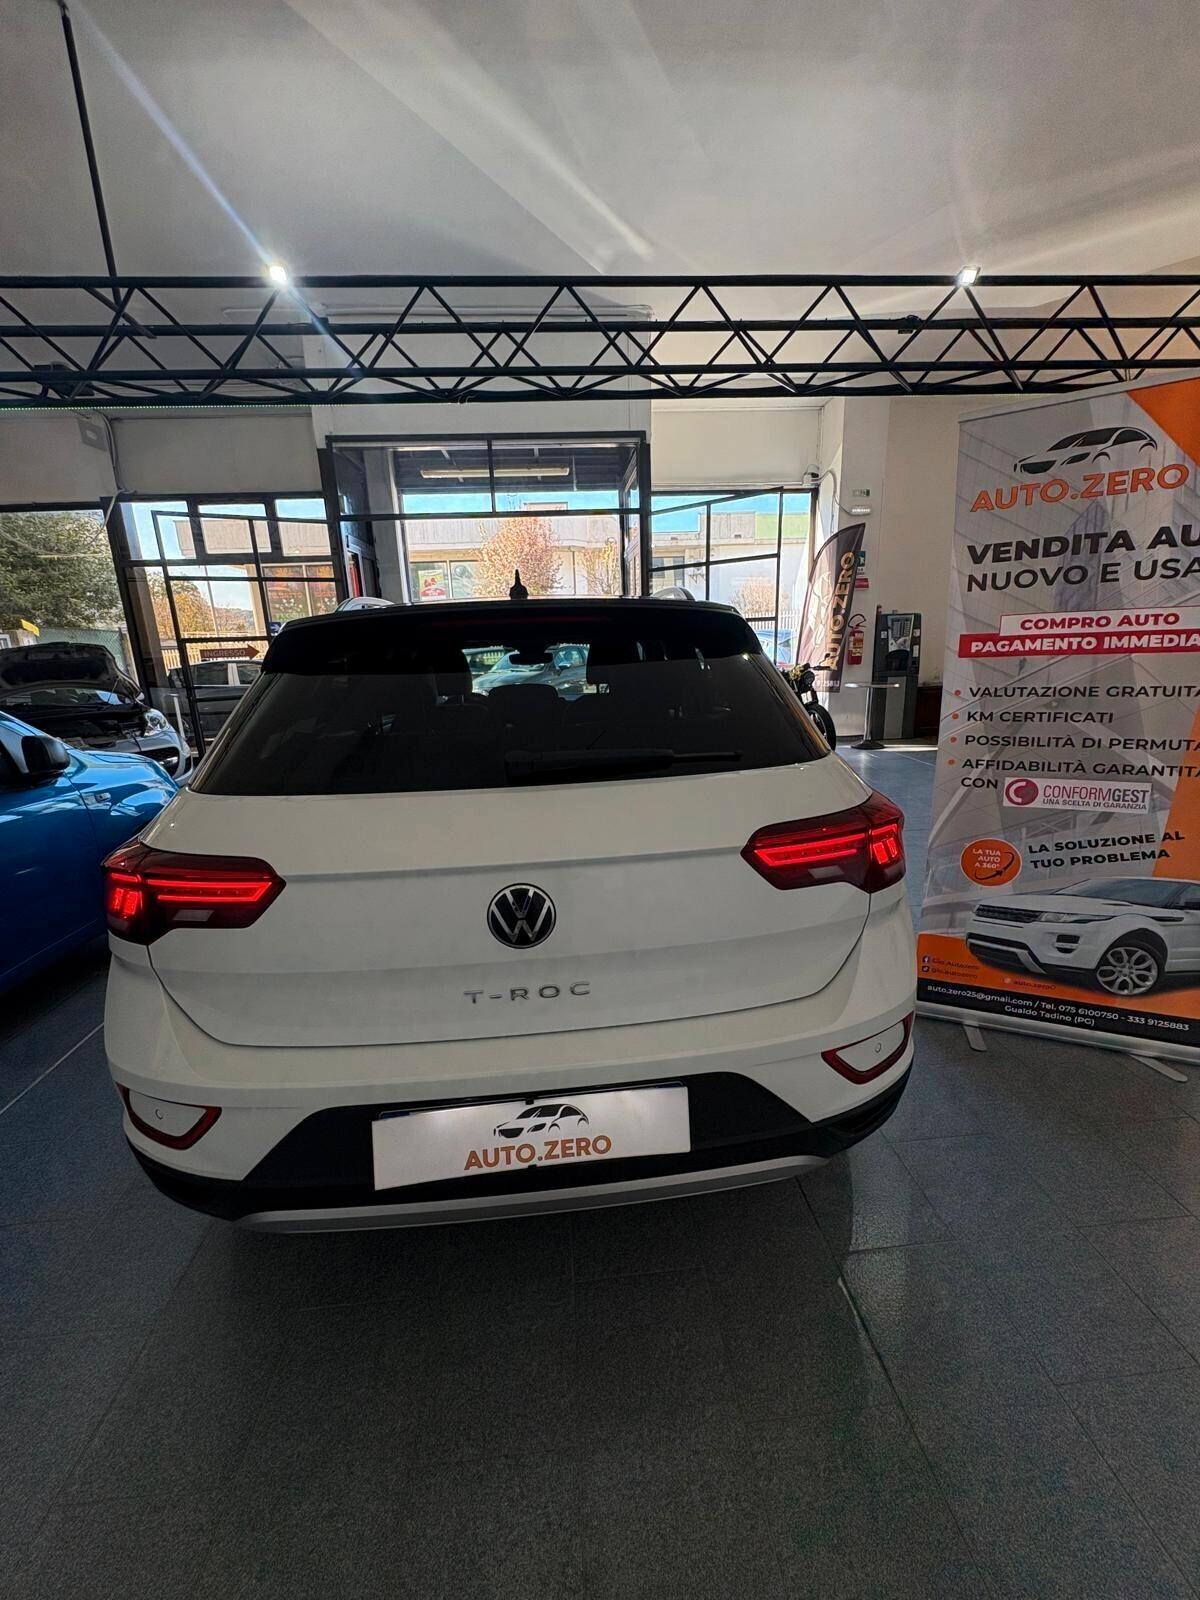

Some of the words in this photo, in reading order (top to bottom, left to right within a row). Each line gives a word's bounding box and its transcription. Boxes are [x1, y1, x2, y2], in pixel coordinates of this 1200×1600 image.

[970, 463, 1189, 513] AUTO.ZERO
[966, 529, 1136, 565] VENDITA
[1146, 524, 1200, 550] AU
[966, 565, 1089, 592] NUOVO
[1100, 562, 1121, 583] E
[1020, 615, 1111, 631] COMPRO
[1117, 612, 1180, 627] AUTO
[203, 648, 246, 658] INGRESSO
[970, 636, 1097, 653] PAGAMENTO
[969, 686, 1100, 698] VALUTAZIONE
[967, 711, 994, 723] KM
[999, 711, 1114, 724] CERTIFICATI
[964, 732, 1074, 749] POSSIBILITÀ
[1082, 737, 1101, 750] DI
[962, 757, 1086, 774] AFFIDABILITÀ
[960, 777, 998, 790] CON
[1043, 784, 1149, 804] CONFORMGEST
[1042, 798, 1060, 807] UNA
[1061, 799, 1091, 808] SCELTA
[1102, 802, 1147, 811] GARANZIA
[1028, 843, 1050, 854] LA
[1054, 833, 1156, 852] SOLUZIONE
[1161, 831, 1185, 843] AL
[977, 855, 1001, 863] AUTO
[984, 849, 1001, 857] TUA
[1030, 857, 1066, 870] TUO
[1069, 848, 1171, 868] PROBLEMA
[463, 981, 591, 1004] T-ROC
[927, 984, 1033, 1008] auto.zero25@gmail.com
[1040, 1001, 1057, 1012] Tel.
[1058, 1003, 1076, 1014] 075
[1078, 1006, 1119, 1020] 6100750
[1127, 1014, 1146, 1026] 333
[1147, 1018, 1189, 1031] 9125883
[1004, 1004, 1037, 1016] Gualdo
[1040, 1010, 1072, 1023] Tadino
[1074, 1014, 1095, 1027] (PG)
[464, 1135, 612, 1171] AUTO.ZERO
